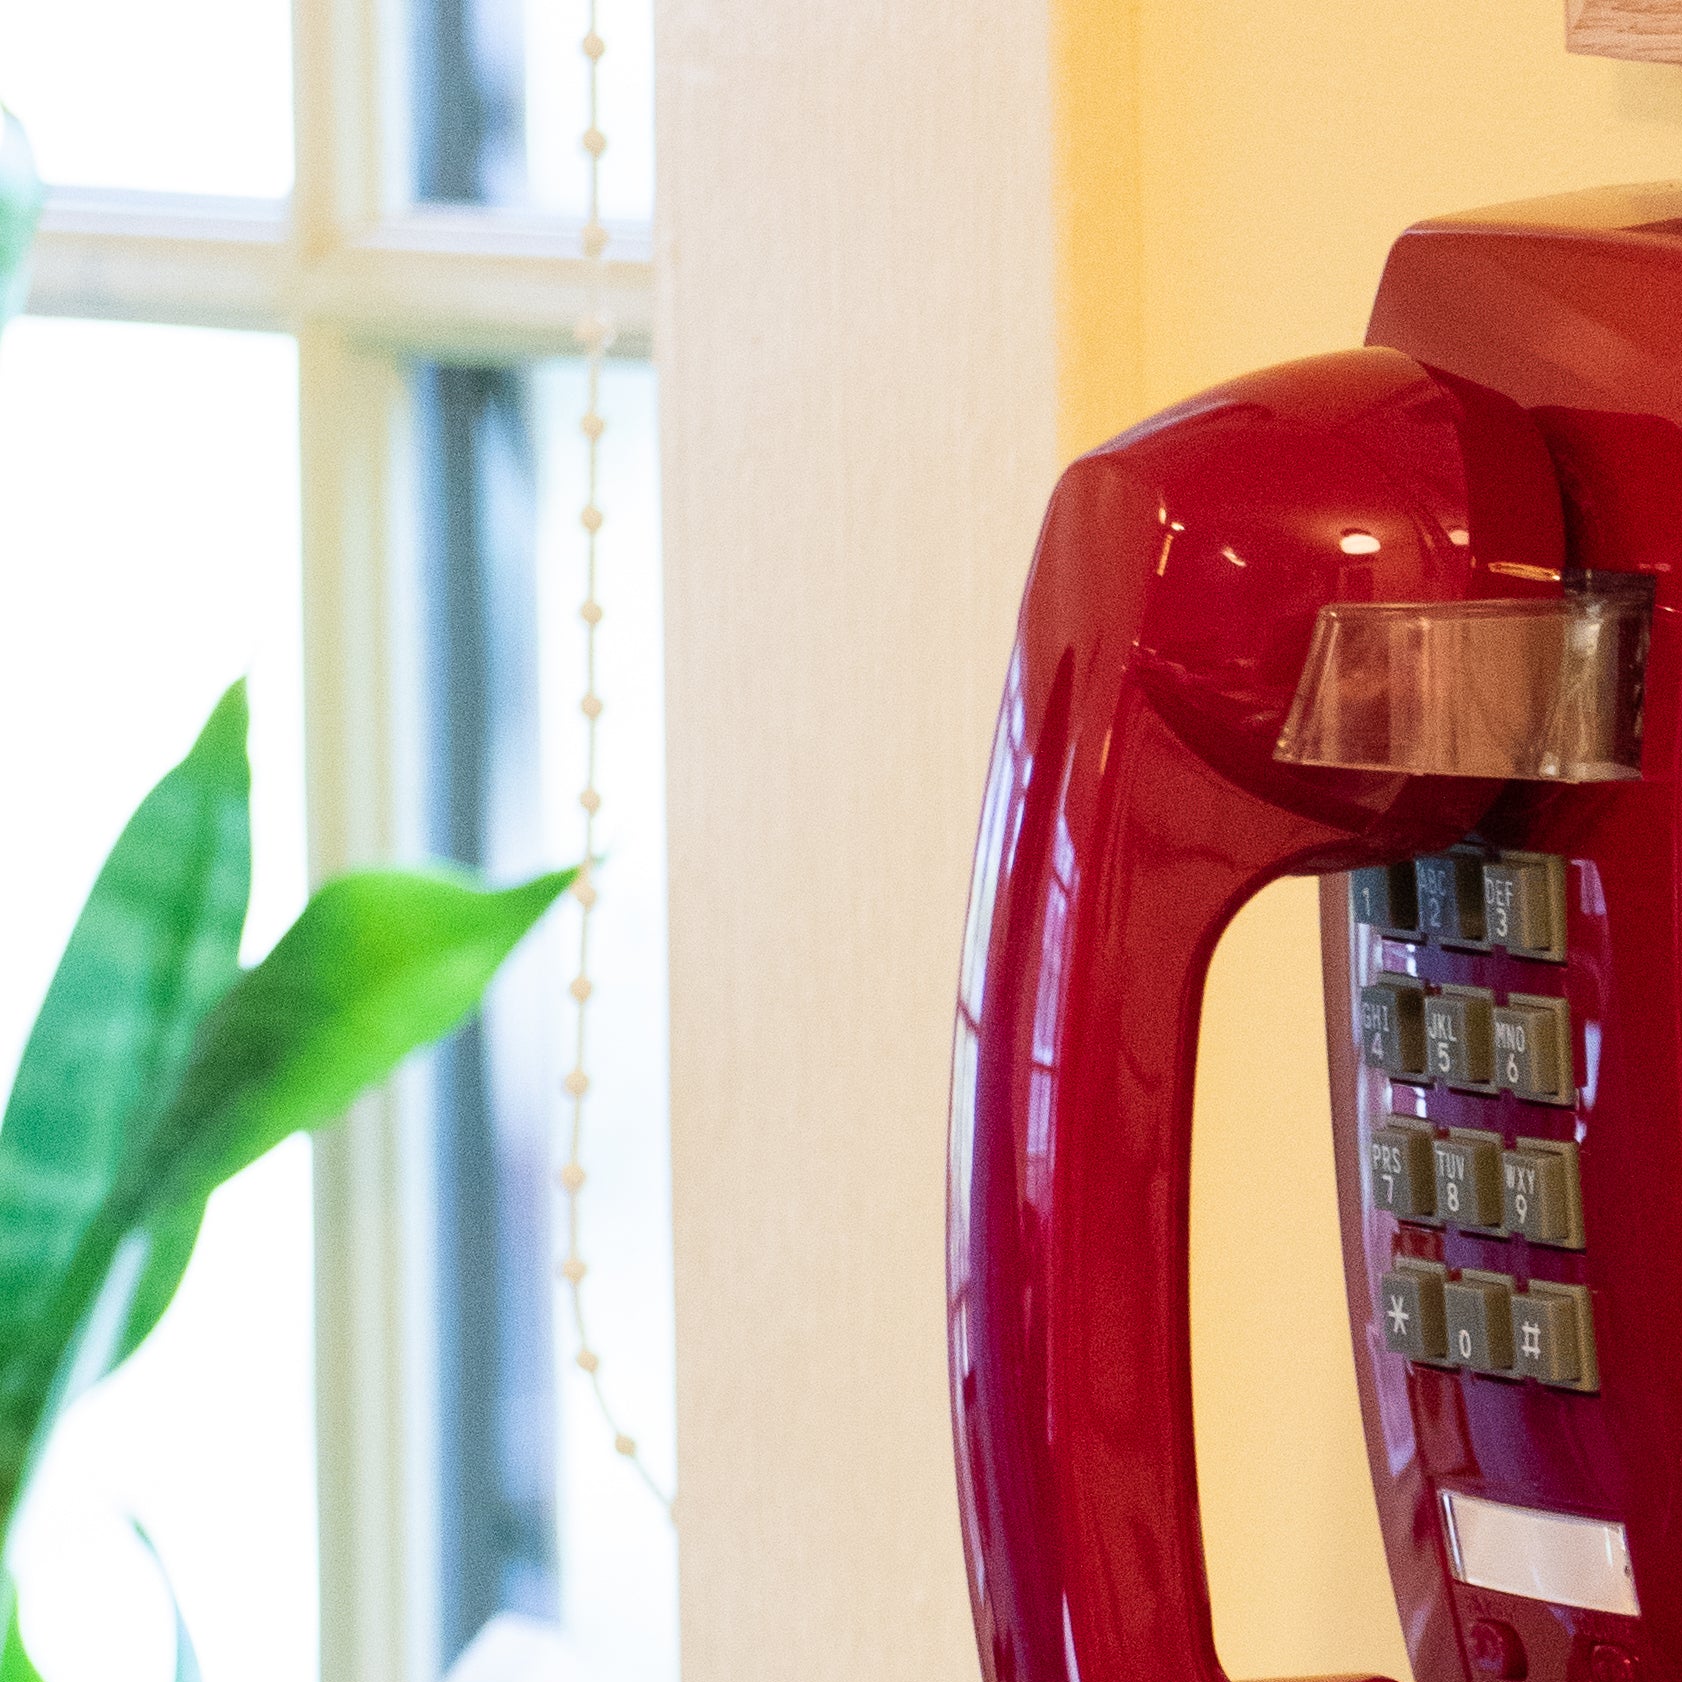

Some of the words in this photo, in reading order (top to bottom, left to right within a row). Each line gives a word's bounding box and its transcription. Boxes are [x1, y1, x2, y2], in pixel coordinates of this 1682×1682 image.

[1416, 867, 1447, 897] ABC
[1484, 877, 1514, 908] DEF
[1361, 887, 1372, 917] 1
[1427, 898, 1441, 928] 2
[1495, 908, 1508, 937] 3
[1363, 1002, 1390, 1034] GHI
[1429, 1012, 1457, 1042] JKL
[1371, 1031, 1384, 1060] 4
[1495, 1022, 1526, 1053] MNO
[1437, 1043, 1450, 1073] 5
[1505, 1053, 1519, 1084] 6
[1372, 1143, 1401, 1174] PRS
[1435, 1150, 1465, 1182] TUV
[1381, 1174, 1394, 1204] 7
[1505, 1165, 1535, 1195] WXY
[1446, 1182, 1460, 1212] 8
[1515, 1194, 1528, 1224] 9
